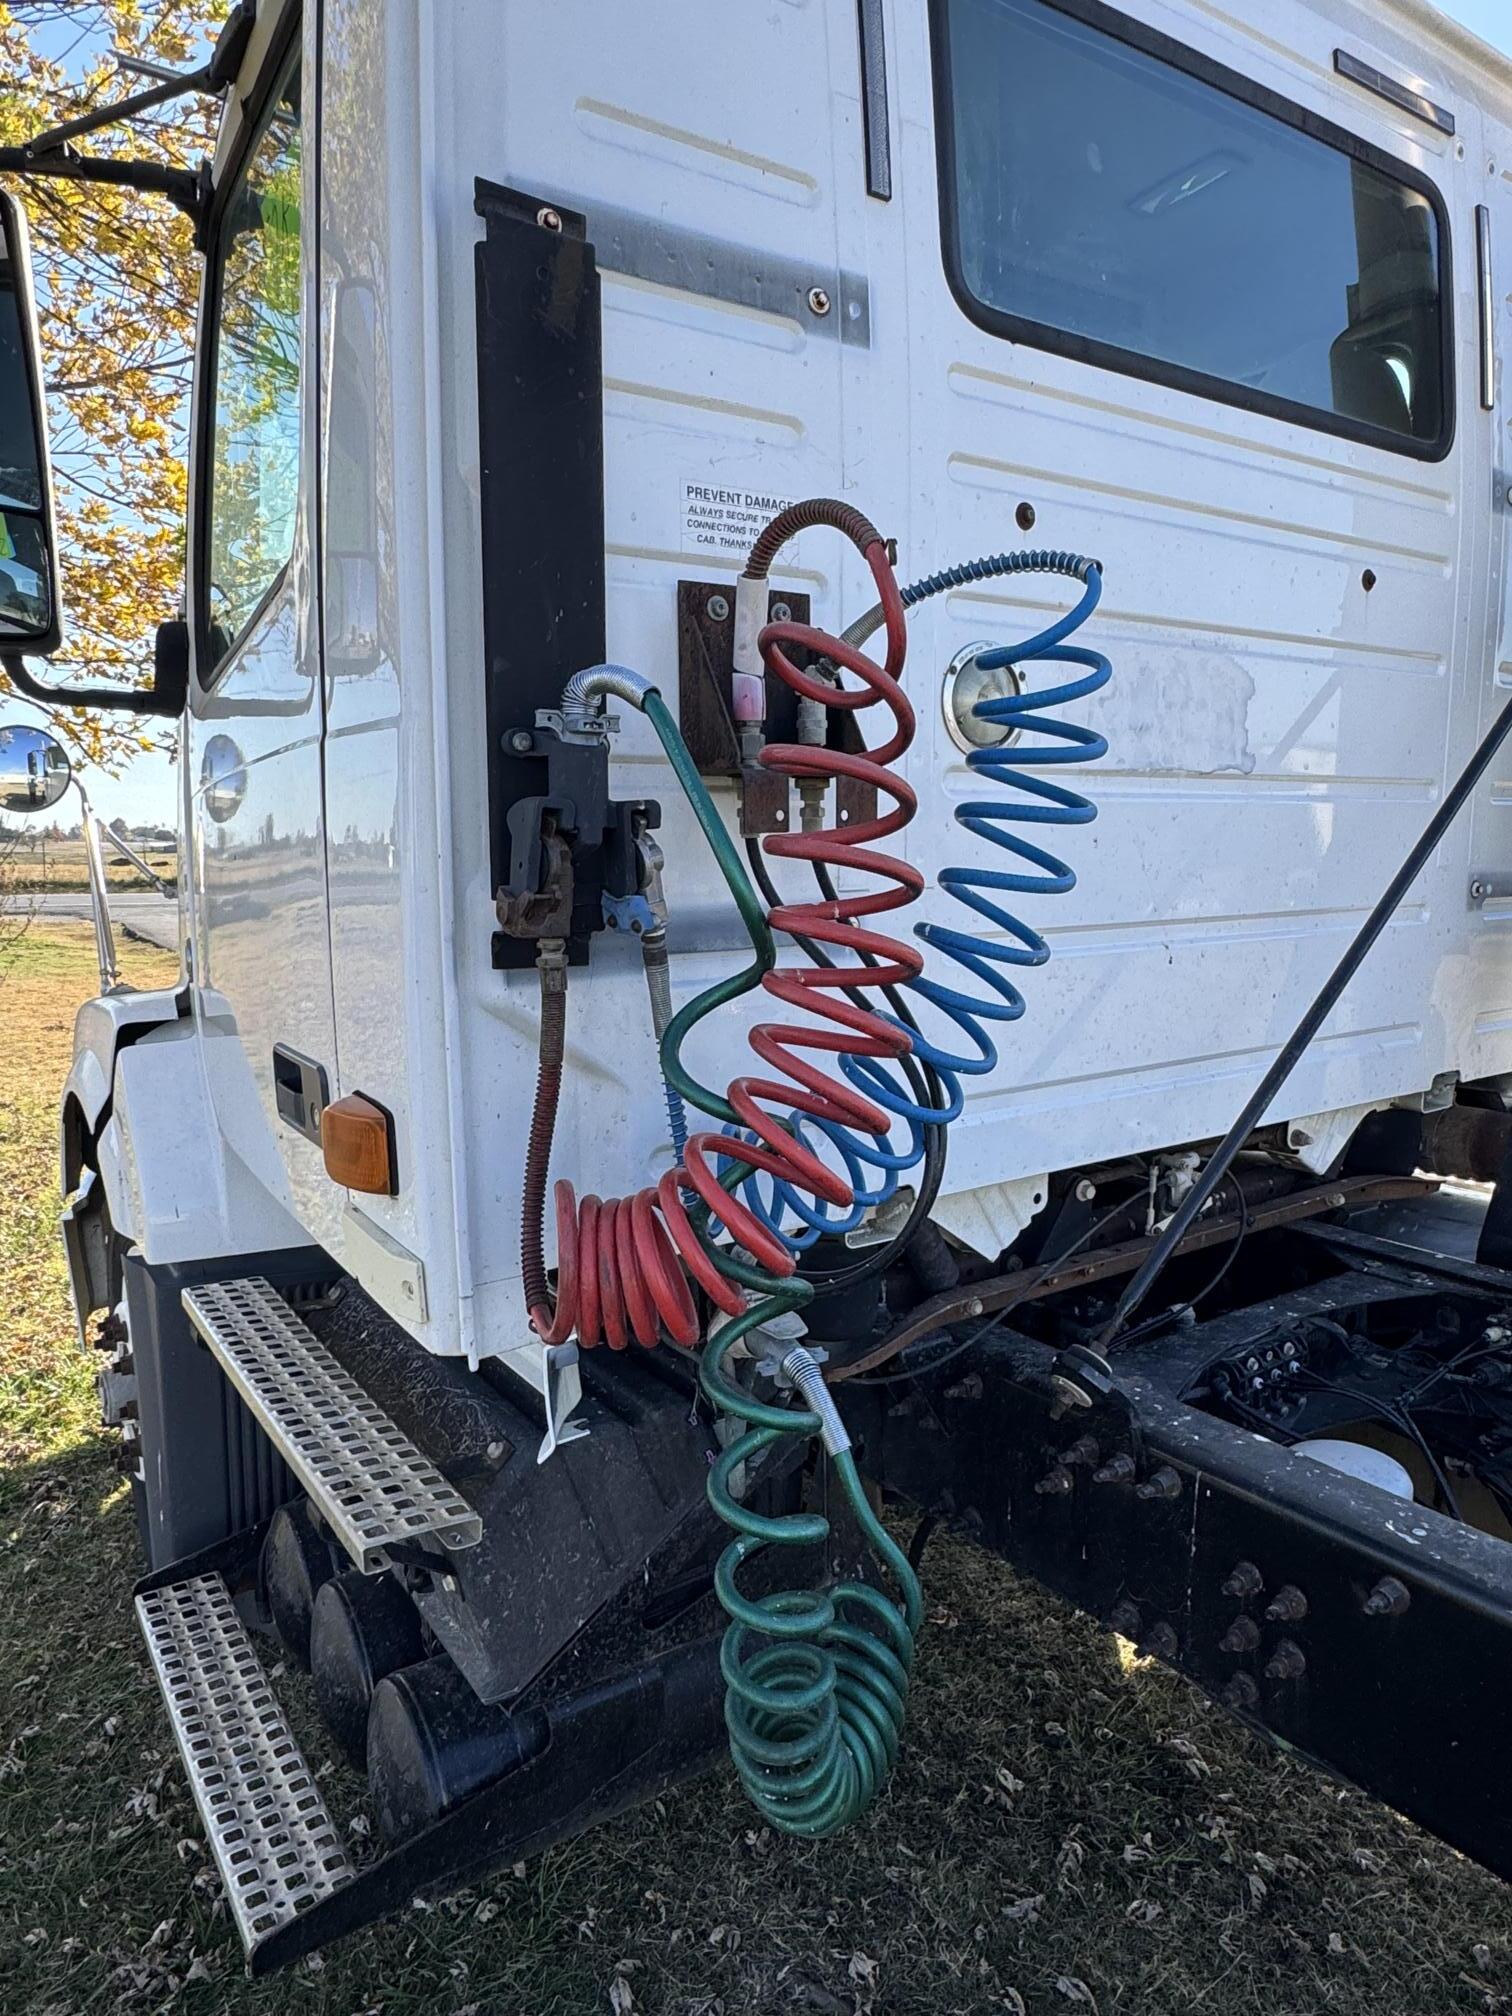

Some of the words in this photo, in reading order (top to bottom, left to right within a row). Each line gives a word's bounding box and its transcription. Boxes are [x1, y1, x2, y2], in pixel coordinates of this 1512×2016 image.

[687, 485, 742, 504] PREVENT
[688, 505, 724, 518] ALWAYS
[726, 510, 759, 523] SECURE
[687, 518, 746, 535] CONNECTIONS
[749, 527, 760, 537] TO
[720, 537, 752, 550] THANKS
